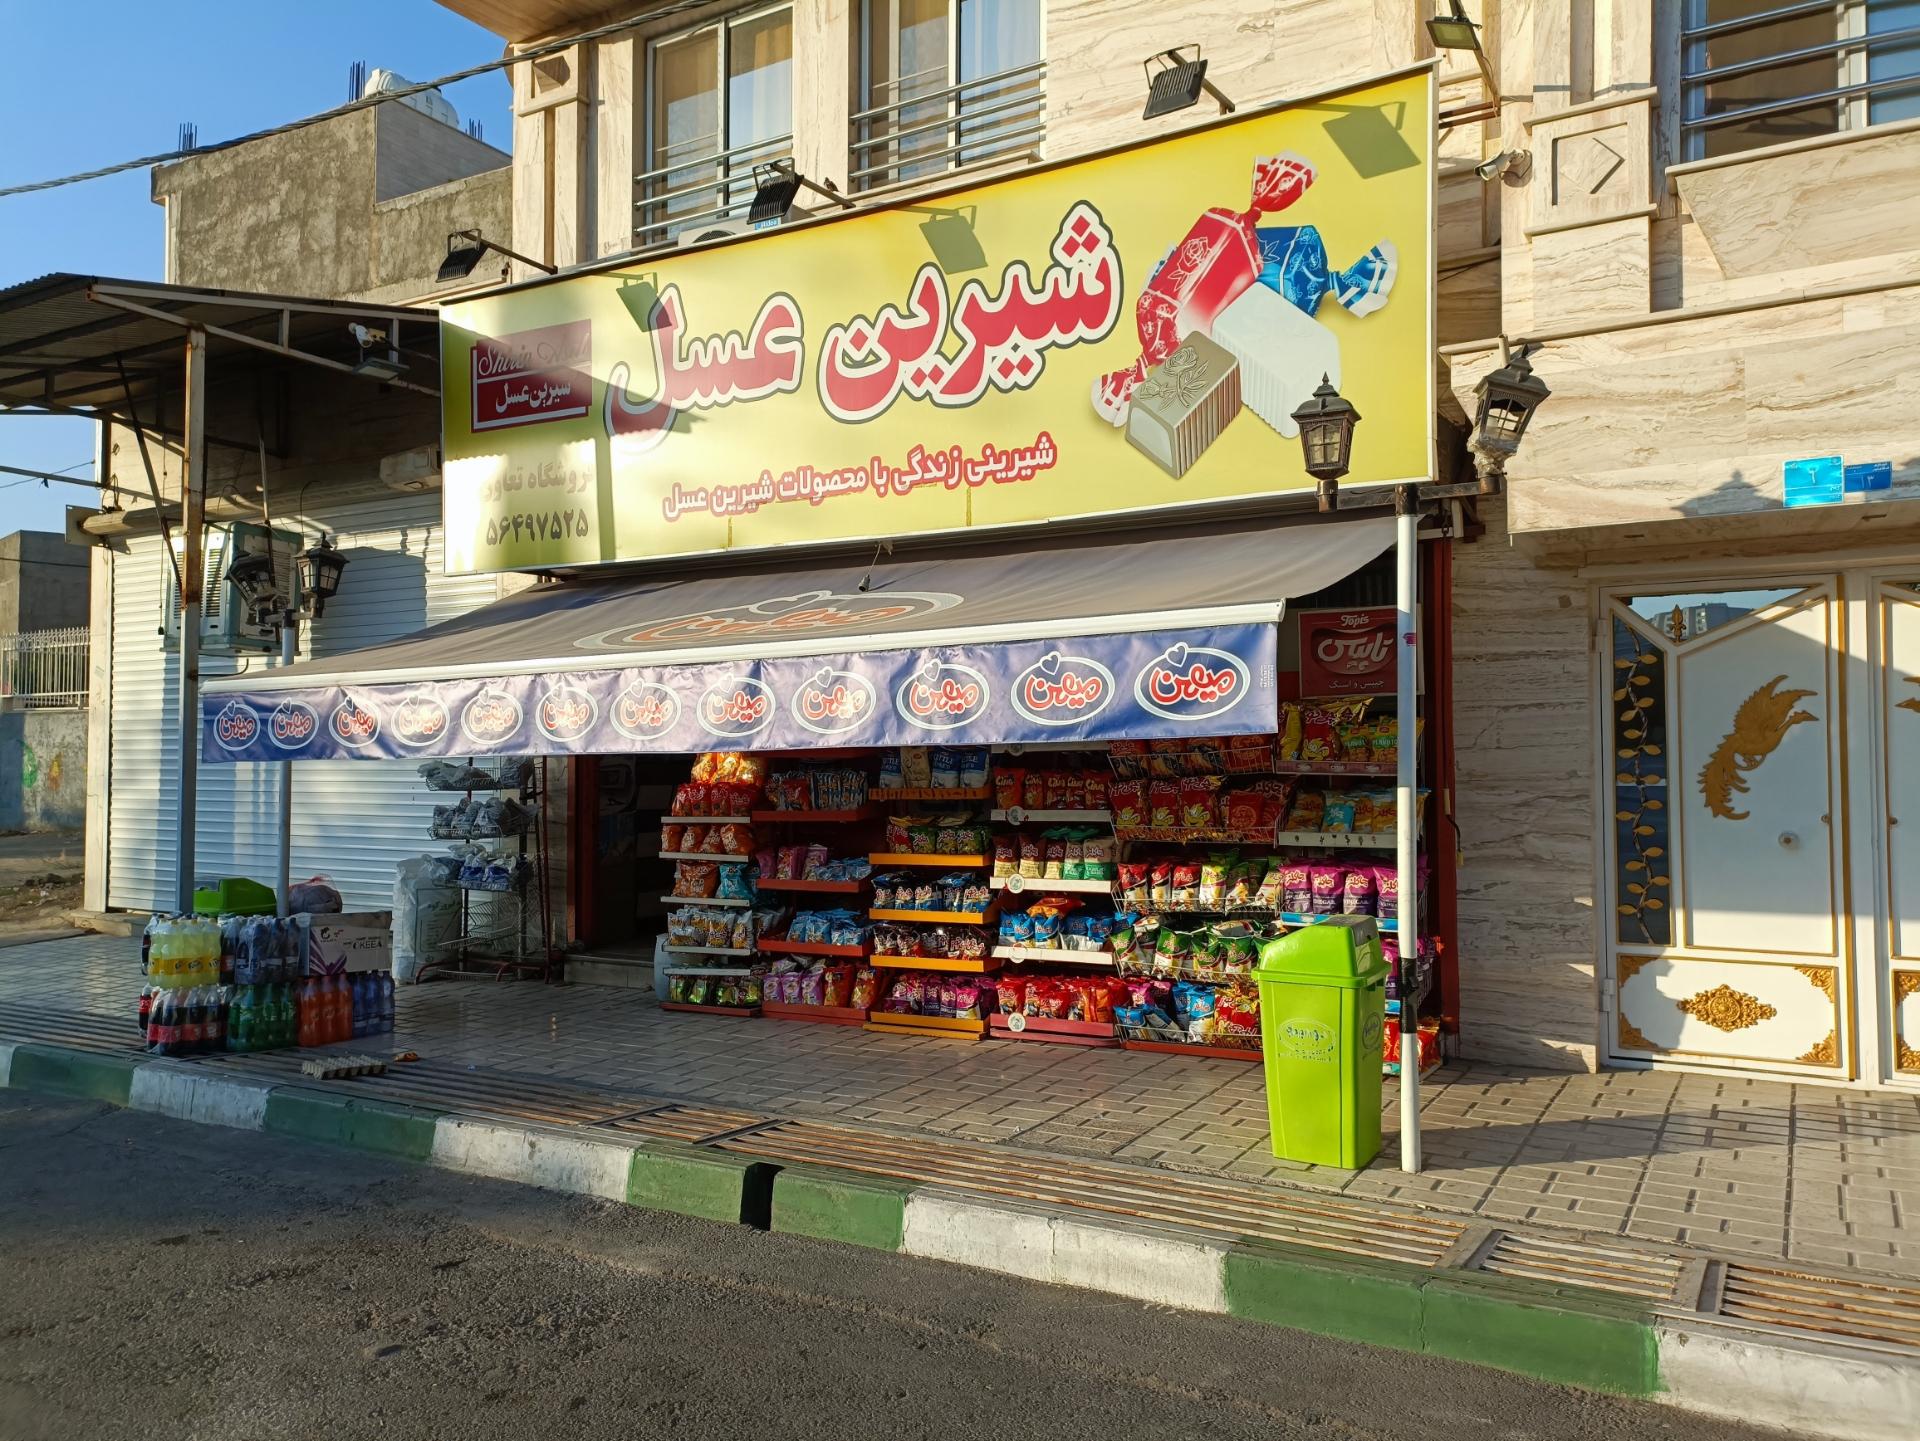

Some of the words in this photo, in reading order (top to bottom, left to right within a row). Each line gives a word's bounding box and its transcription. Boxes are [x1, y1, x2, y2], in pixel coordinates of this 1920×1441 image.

[817, 200, 1123, 423] شیرین
[604, 283, 804, 450] عسل
[495, 382, 529, 413] عسل
[872, 457, 889, 496] با
[894, 445, 960, 494] زندگی
[966, 433, 1056, 486] شیرینی
[664, 483, 708, 521] عسل
[712, 471, 774, 515] شیرین
[779, 467, 867, 505] محصولات
[486, 508, 589, 546] ۵۶۴۹۷۵۲۵
[1341, 613, 1370, 627] Topis
[803, 684, 868, 721] میهن
[909, 677, 980, 717] میهن
[1023, 669, 1103, 713] میهن
[1148, 662, 1238, 706] میهن
[337, 711, 375, 737] میهن
[619, 696, 670, 729] میهن
[706, 688, 769, 726] میهن
[220, 717, 255, 742] میهن
[274, 714, 314, 740] میهن
